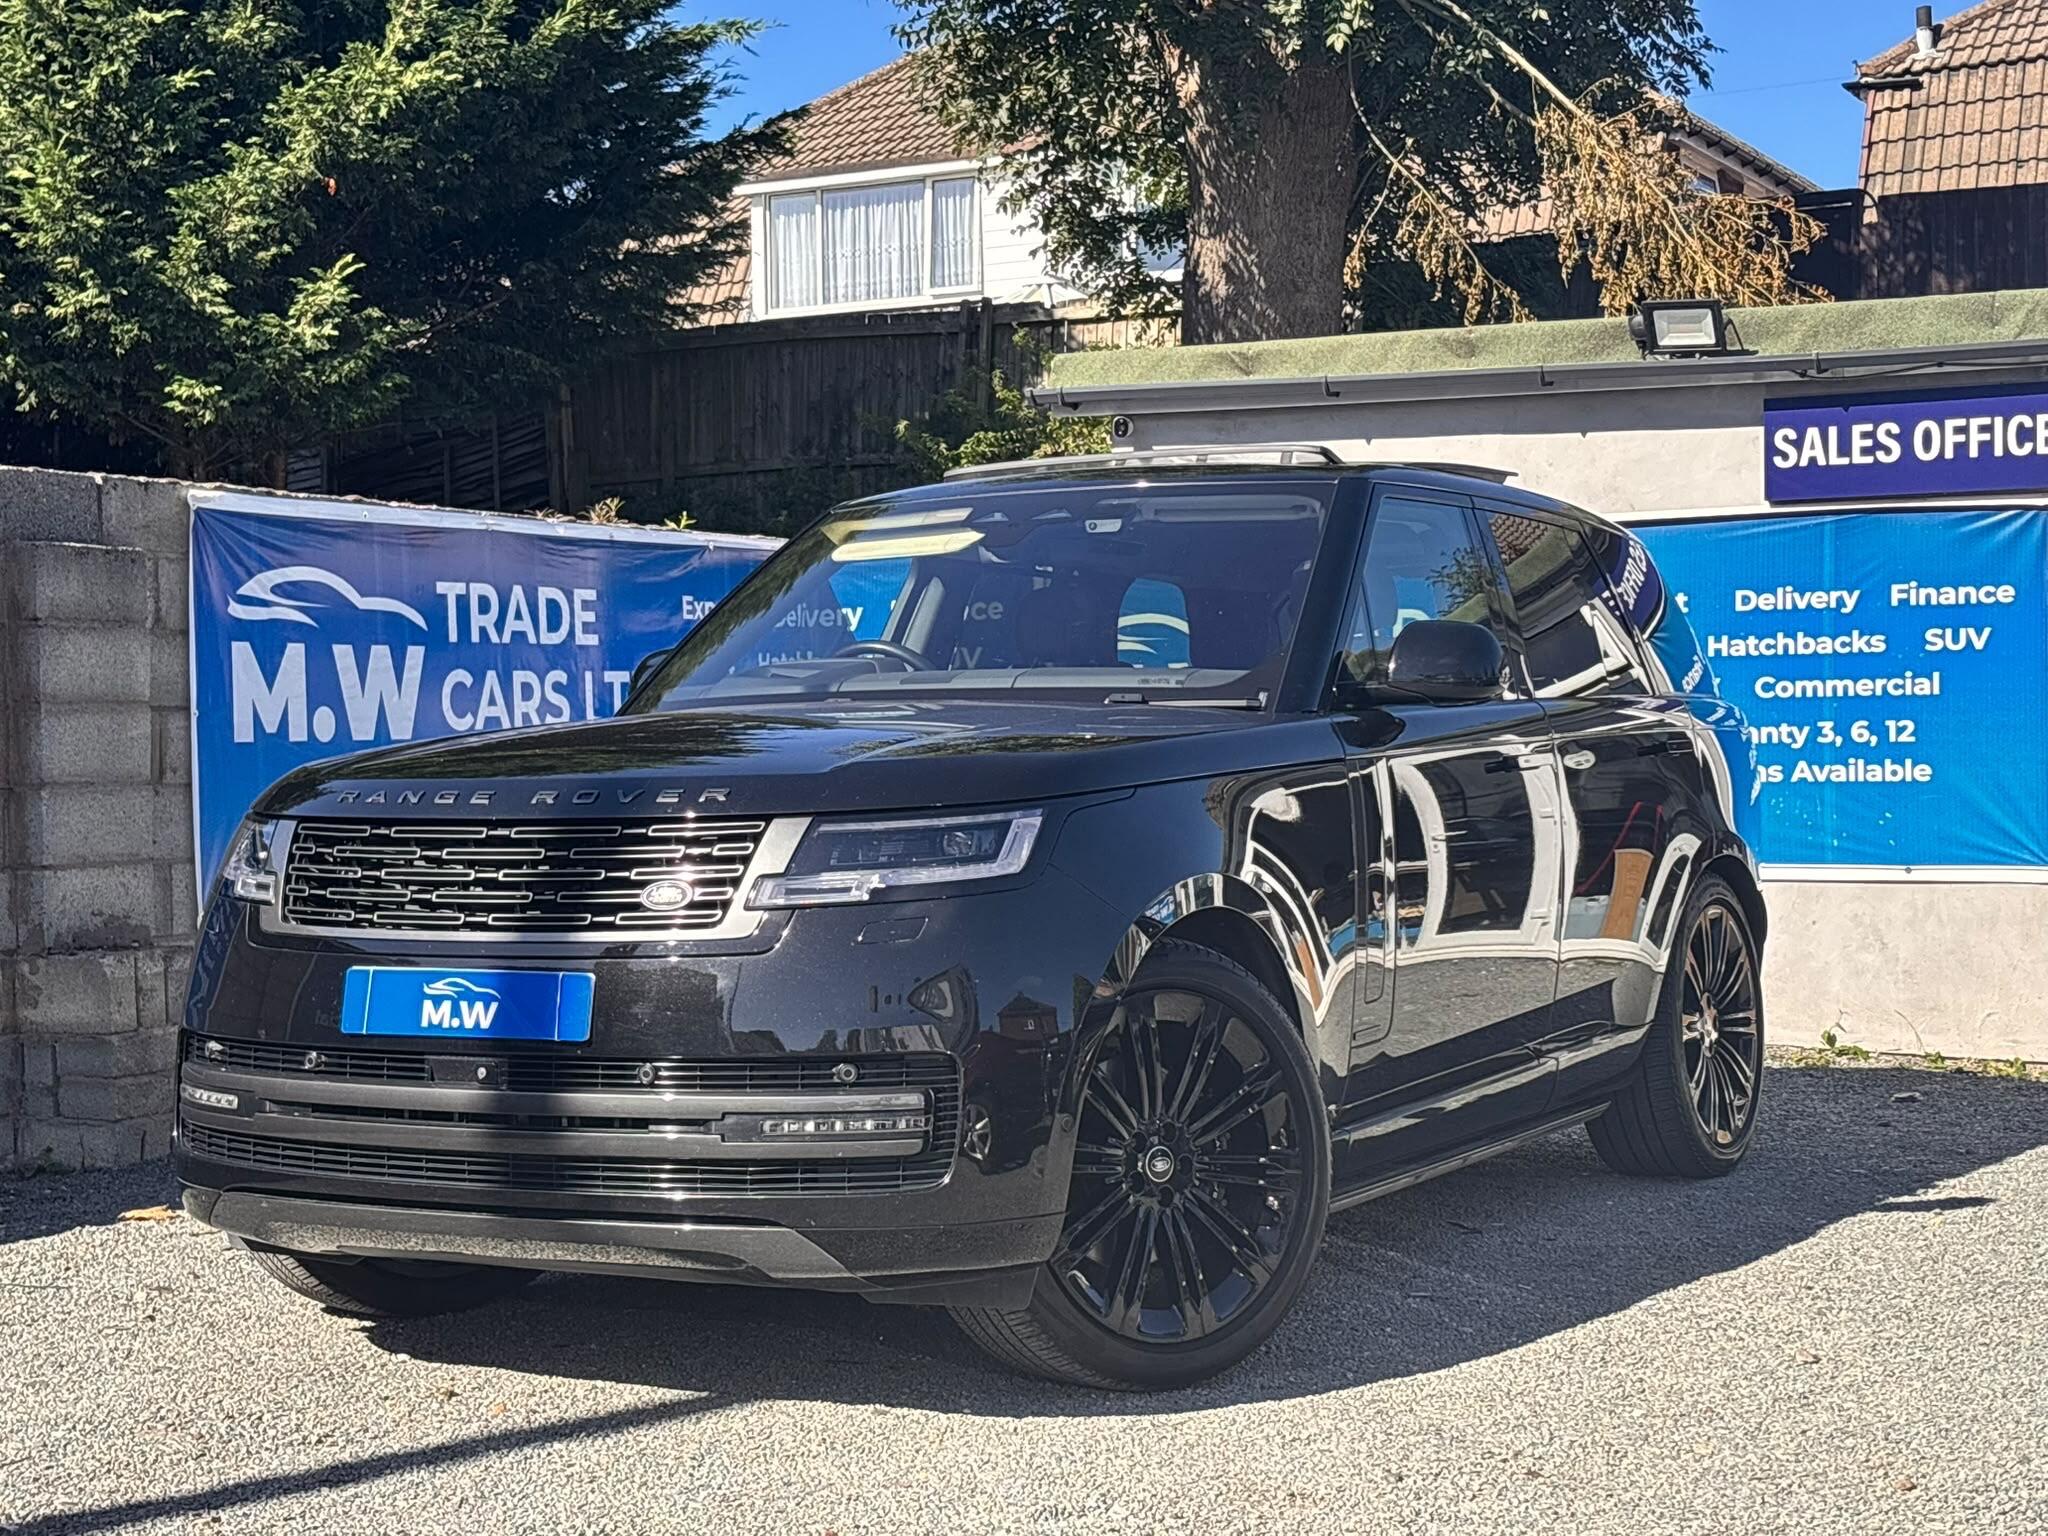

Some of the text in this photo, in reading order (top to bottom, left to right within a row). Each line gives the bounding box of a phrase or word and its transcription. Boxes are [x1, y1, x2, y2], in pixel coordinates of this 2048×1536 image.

[1772, 421, 1901, 469] SALES
[1734, 585, 1861, 614] Delivery
[1890, 580, 2016, 607] Finance
[435, 581, 600, 646] TRADE
[1707, 626, 1992, 658] Hatchbacks SUV
[231, 640, 426, 744] M.W
[441, 668, 632, 732] CARS LT
[1754, 670, 1941, 699] Commercial
[1816, 720, 1844, 747] 3,
[1850, 719, 1879, 747] 6,
[1885, 719, 1916, 743] 12
[1790, 757, 1934, 783] Available
[336, 787, 733, 806] RANGE ROVER
[420, 999, 499, 1030] M.W
